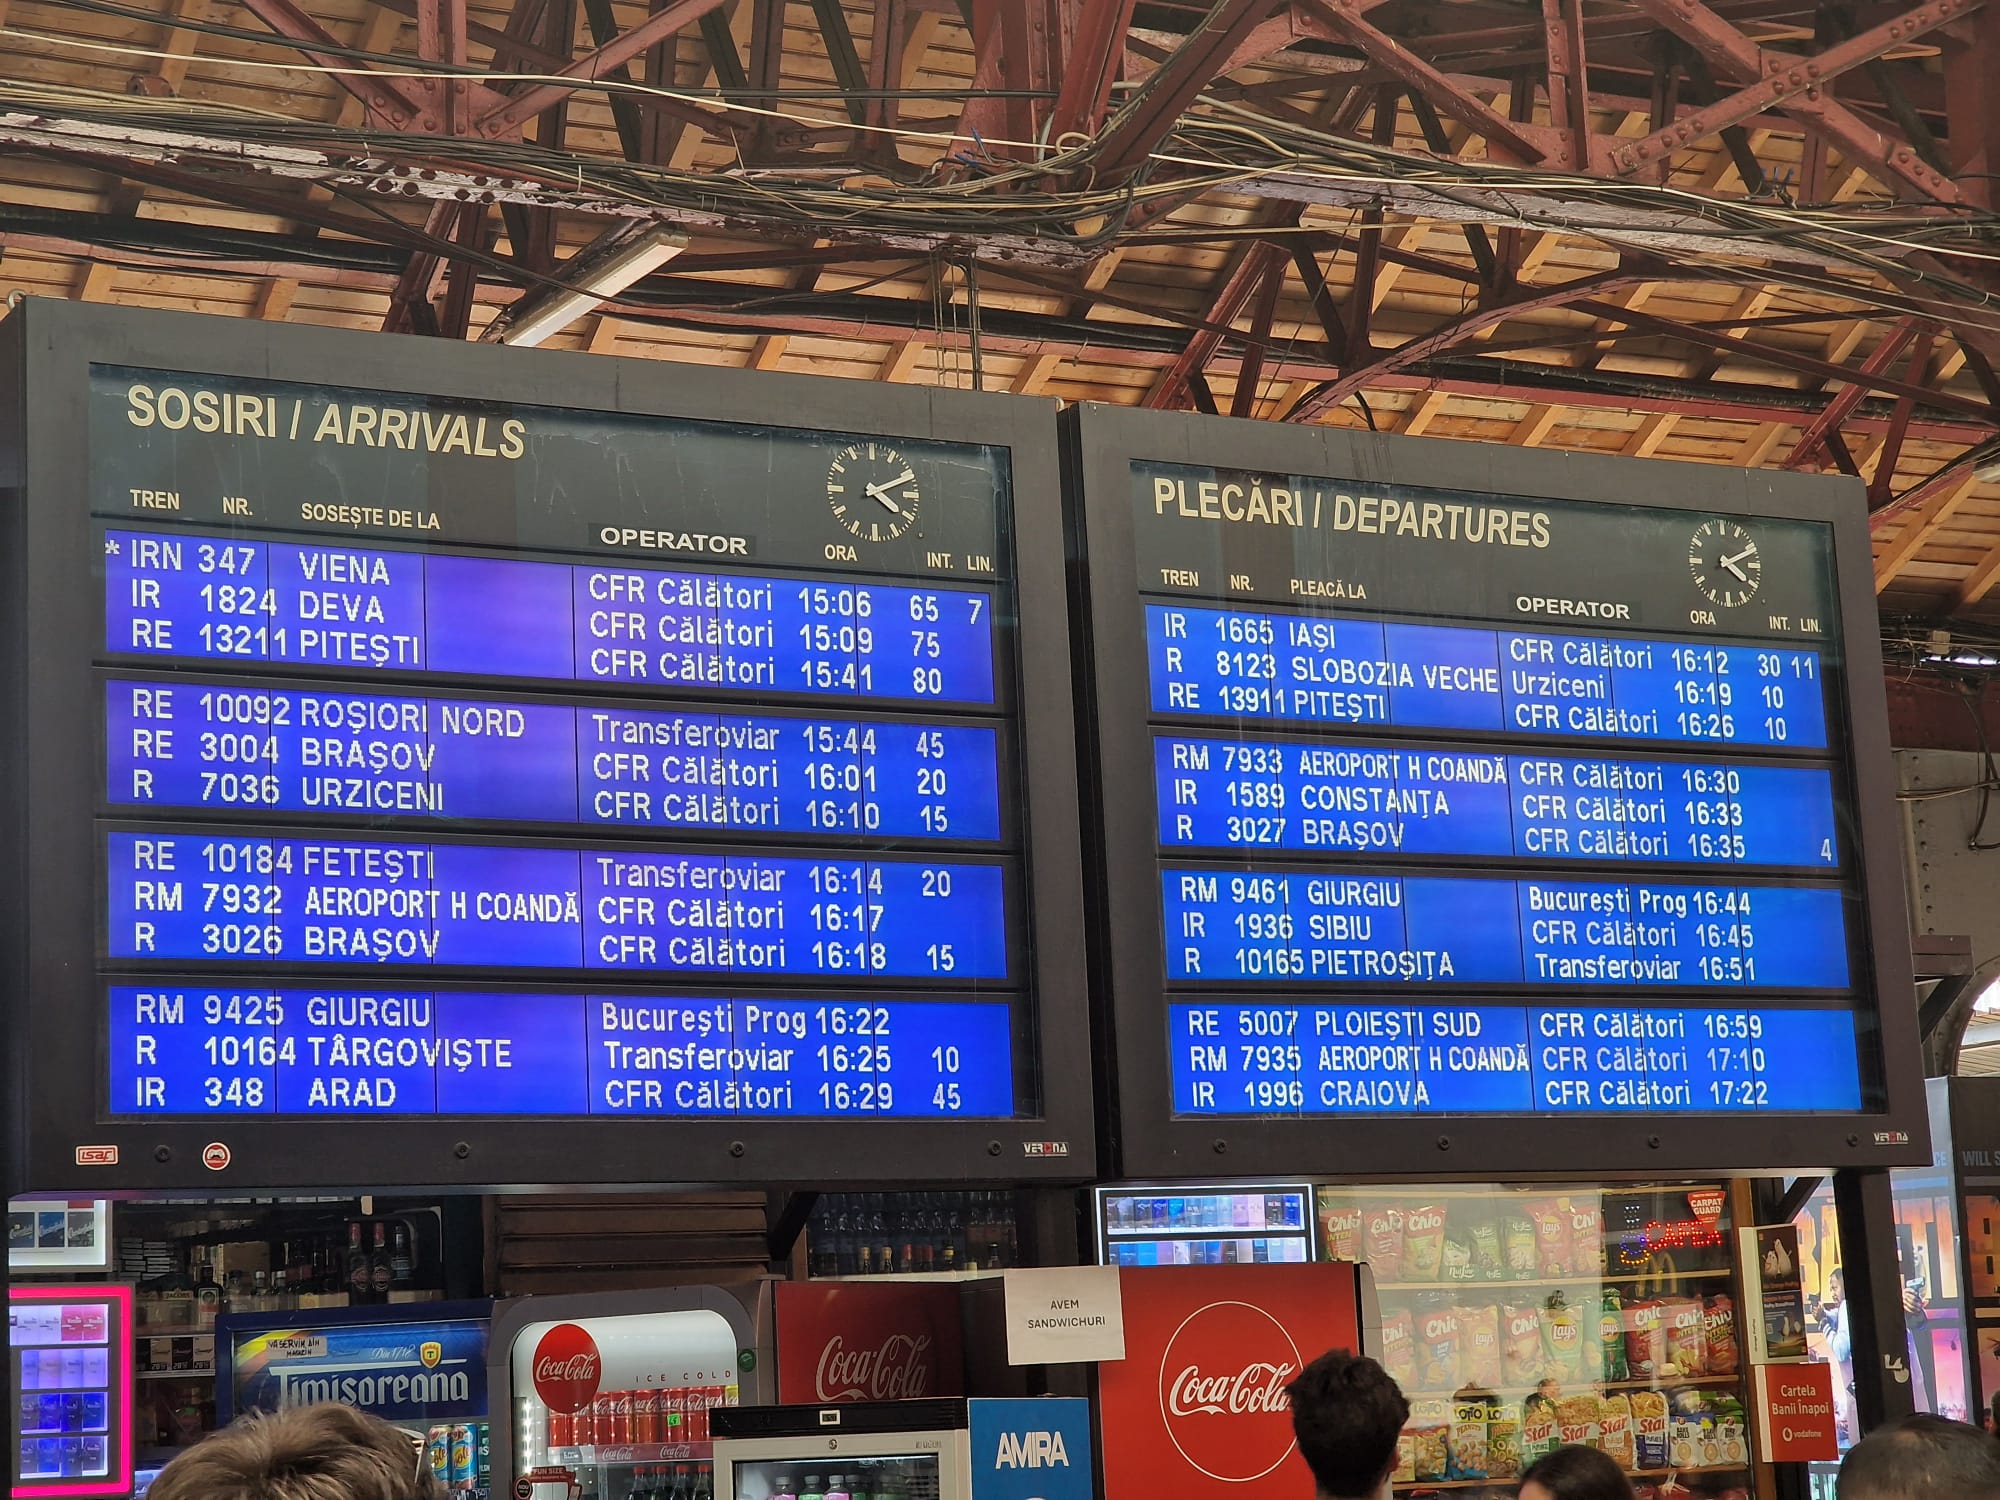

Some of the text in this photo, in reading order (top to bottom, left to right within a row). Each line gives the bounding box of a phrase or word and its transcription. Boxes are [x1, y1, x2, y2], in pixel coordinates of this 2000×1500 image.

[127, 384, 527, 460] SOSIRI / ARRIVALS
[130, 488, 995, 573] TREN NR. SOSEȘTE DE LA OPERATOR ORA INT. LIN.
[1153, 477, 1552, 549] PLECĂRI / DEPARTURES
[131, 538, 983, 625] IRN 347 VIENA CFR Călători 15:06 65 7
[1160, 568, 1823, 634] TREN NR. PLEACĂ LA OPERATOR ORA INT. LIN.
[1164, 612, 1813, 680] IR 1665 IAȘI CFR Călători 16:12 30 11
[1166, 647, 1784, 709] R 8123 SLOBOZIA VECHE Urziceni 16:19 10
[132, 688, 945, 759] RE 10092 ROȘIORI NORD Transferoviar 15:44 45
[133, 728, 946, 796] RE 3004 BRAȘOV CFR Călători 16:01 20
[1174, 778, 1743, 827] IR 1589 CONSTANȚA CFR Călători 16:33
[135, 880, 884, 932] RM 7932 AEROPORT H COANDĂ CFR Călători 16:17
[1184, 947, 1755, 981] R 10165 PIETROȘIȚA Transferoviar 16:51
[136, 994, 890, 1039] RM 9425 GIURGIU București Prog 16:22
[1188, 1010, 1762, 1041] RE 5007 PLOIEȘTI SUD CFR Călători 16:59
[1962, 1150, 1992, 1167] WILL
[1690, 1198, 1723, 1207] CARPAT
[1693, 1206, 1721, 1215] GUARD
[1408, 1213, 1442, 1231] Chio
[1027, 1315, 1106, 1330] SANDWICHURI
[1050, 1299, 1080, 1310] AVEM
[536, 1353, 598, 1383] Coca-Cola
[815, 1335, 932, 1401] Coca-Cola
[1169, 1362, 1297, 1416] Coca-Cola
[1781, 1384, 1817, 1397] Cartela
[1599, 1416, 1629, 1436] Star
[1772, 1399, 1830, 1417] Banii Înapoi
[994, 1431, 1070, 1469] AMIRA
[1524, 1423, 1553, 1444] Star
[1561, 1424, 1591, 1443] Star
[1793, 1428, 1822, 1438] vodafone
